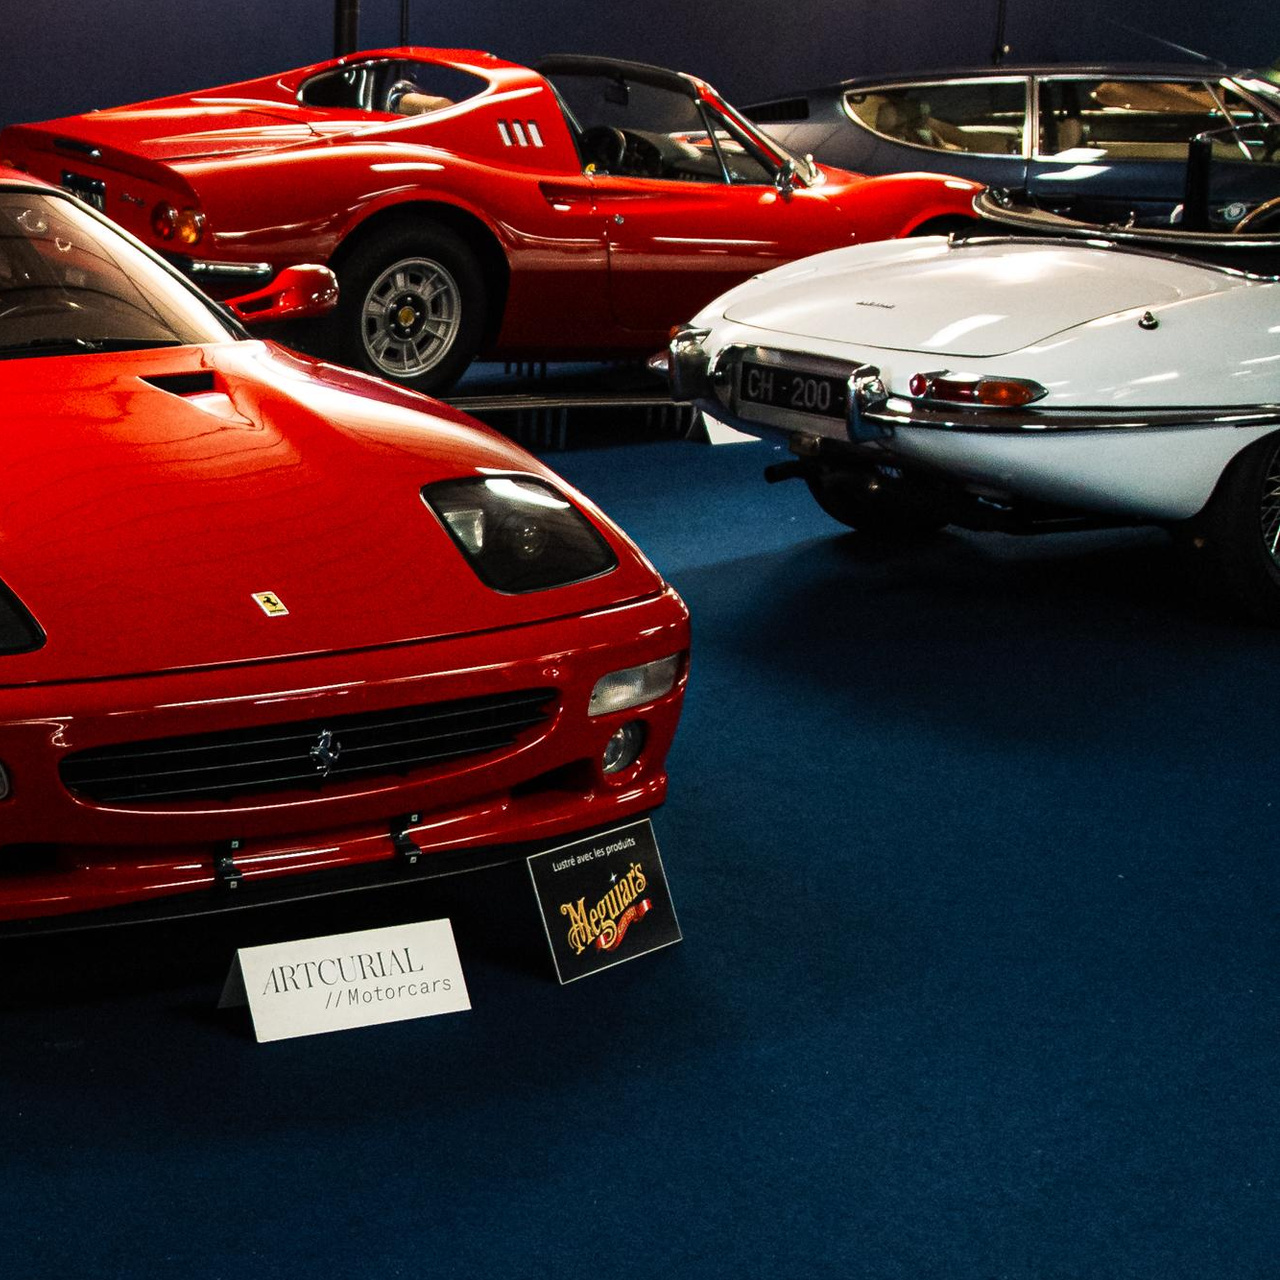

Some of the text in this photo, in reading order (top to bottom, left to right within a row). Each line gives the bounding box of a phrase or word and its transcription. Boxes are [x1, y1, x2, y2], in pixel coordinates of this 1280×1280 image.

[747, 369, 831, 411] CH 200
[552, 837, 636, 872] Lustré avec les produits
[559, 862, 648, 956] Meguiar's
[263, 947, 424, 995] ARTCURIAL
